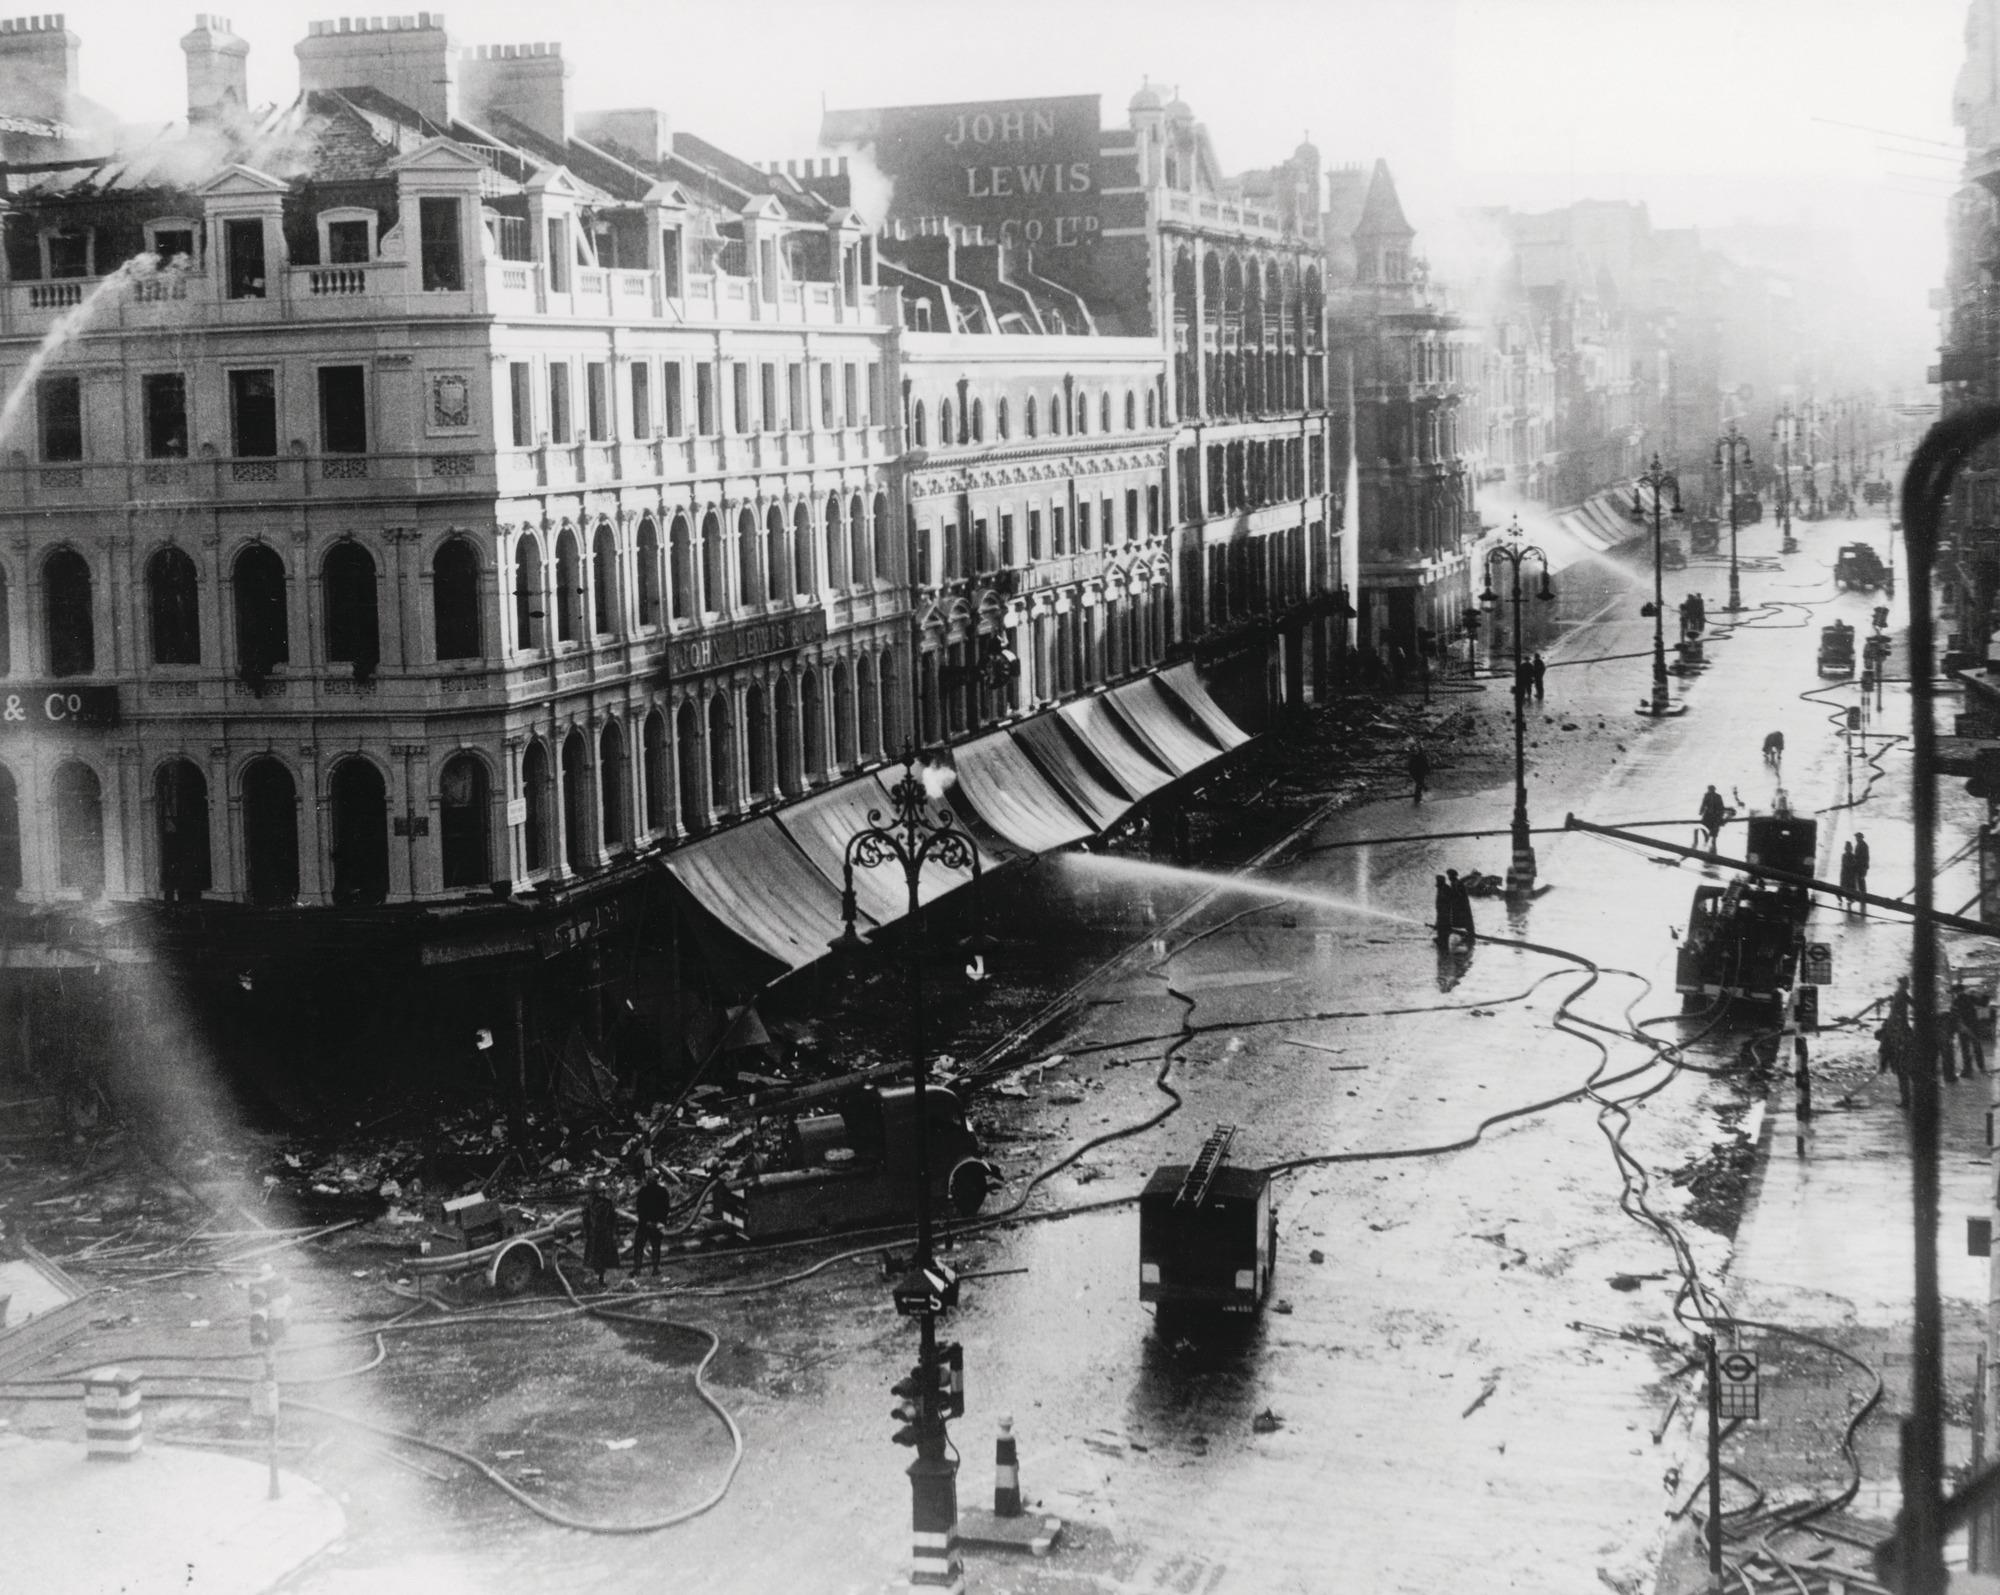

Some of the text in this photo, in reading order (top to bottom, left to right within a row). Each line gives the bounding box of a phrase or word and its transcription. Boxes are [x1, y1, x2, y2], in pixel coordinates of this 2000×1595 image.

[944, 111, 1055, 146] JOHN
[966, 162, 1091, 198] LEWIS
[679, 637, 721, 671] JOHN
[737, 623, 786, 659] LEWIS
[3, 694, 26, 721] &
